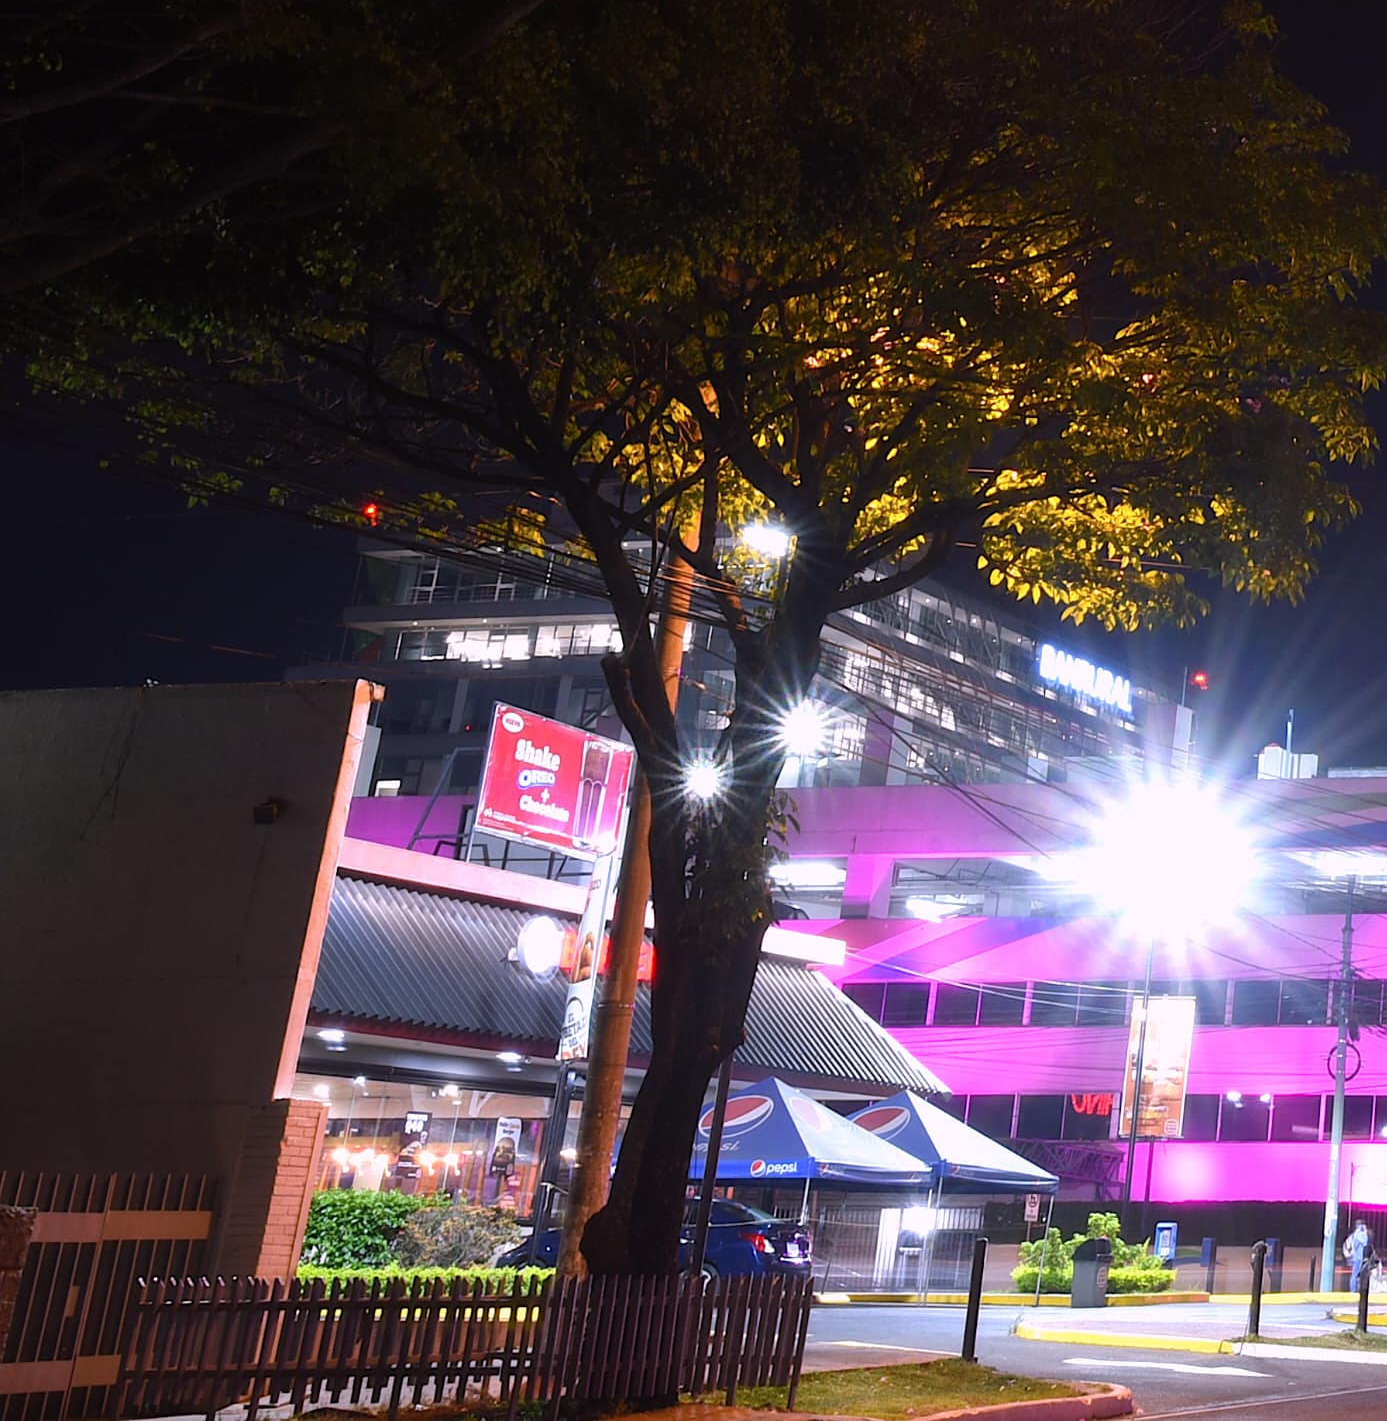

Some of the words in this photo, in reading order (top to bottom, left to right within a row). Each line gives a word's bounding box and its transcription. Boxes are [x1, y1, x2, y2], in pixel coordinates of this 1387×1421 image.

[515, 738, 561, 772] Shake
[517, 768, 556, 788] OREO
[519, 794, 569, 823] Chocolate
[766, 1161, 798, 1175] pepsi
